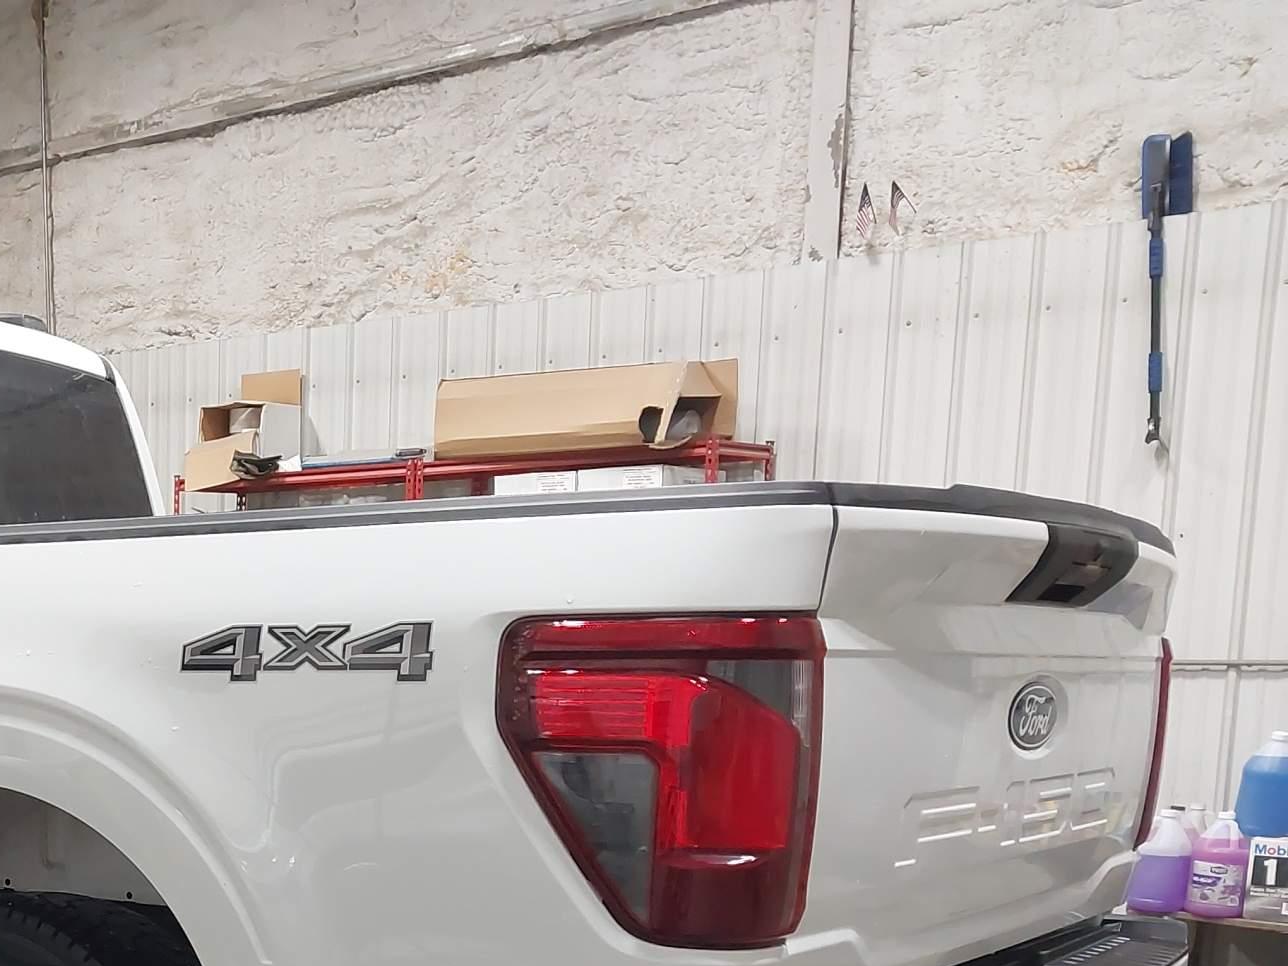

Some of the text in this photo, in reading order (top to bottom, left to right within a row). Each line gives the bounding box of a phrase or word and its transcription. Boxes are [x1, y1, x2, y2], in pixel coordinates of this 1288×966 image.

[1019, 694, 1053, 737] Ford
[1254, 843, 1288, 856] Mob
[1264, 858, 1278, 886] 1
